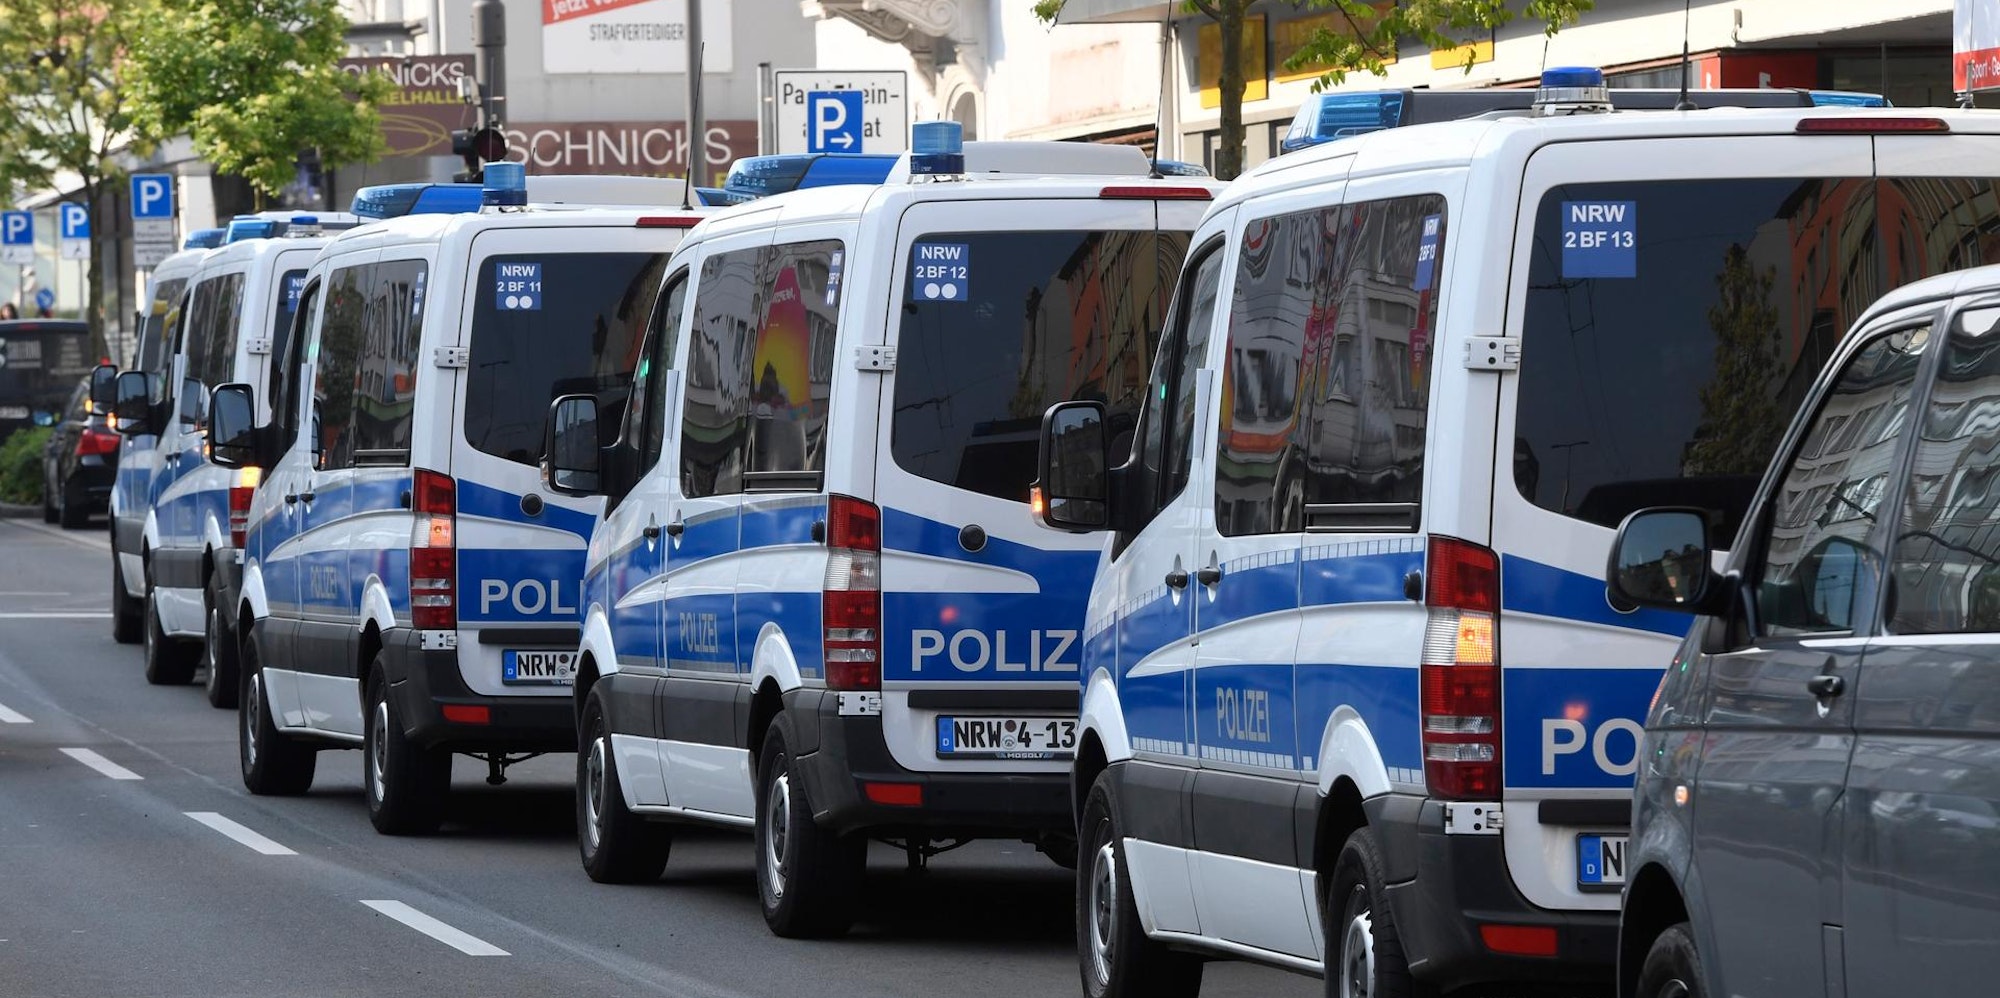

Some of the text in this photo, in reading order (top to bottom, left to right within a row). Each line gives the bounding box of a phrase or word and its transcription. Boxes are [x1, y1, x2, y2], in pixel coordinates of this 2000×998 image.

[589, 24, 685, 41] STRAFVERTEIDIGER
[816, 99, 846, 149] P
[140, 180, 163, 214] P
[67, 207, 87, 236] P
[1571, 205, 1626, 223] NRW
[8, 215, 27, 242] P
[1564, 231, 1634, 248] 2 BF 13
[921, 246, 961, 260] NRW
[502, 265, 535, 277] NRW
[915, 266, 967, 279] 2 BF 12
[288, 290, 295, 299] 2
[497, 281, 541, 292] 2 BF 11
[679, 612, 718, 653] POLIZEI
[911, 629, 1078, 673] POLIZ
[518, 654, 557, 676] NRW
[1216, 687, 1271, 743] POLIZEI
[954, 721, 1001, 748] NRW
[1586, 864, 1595, 874] D
